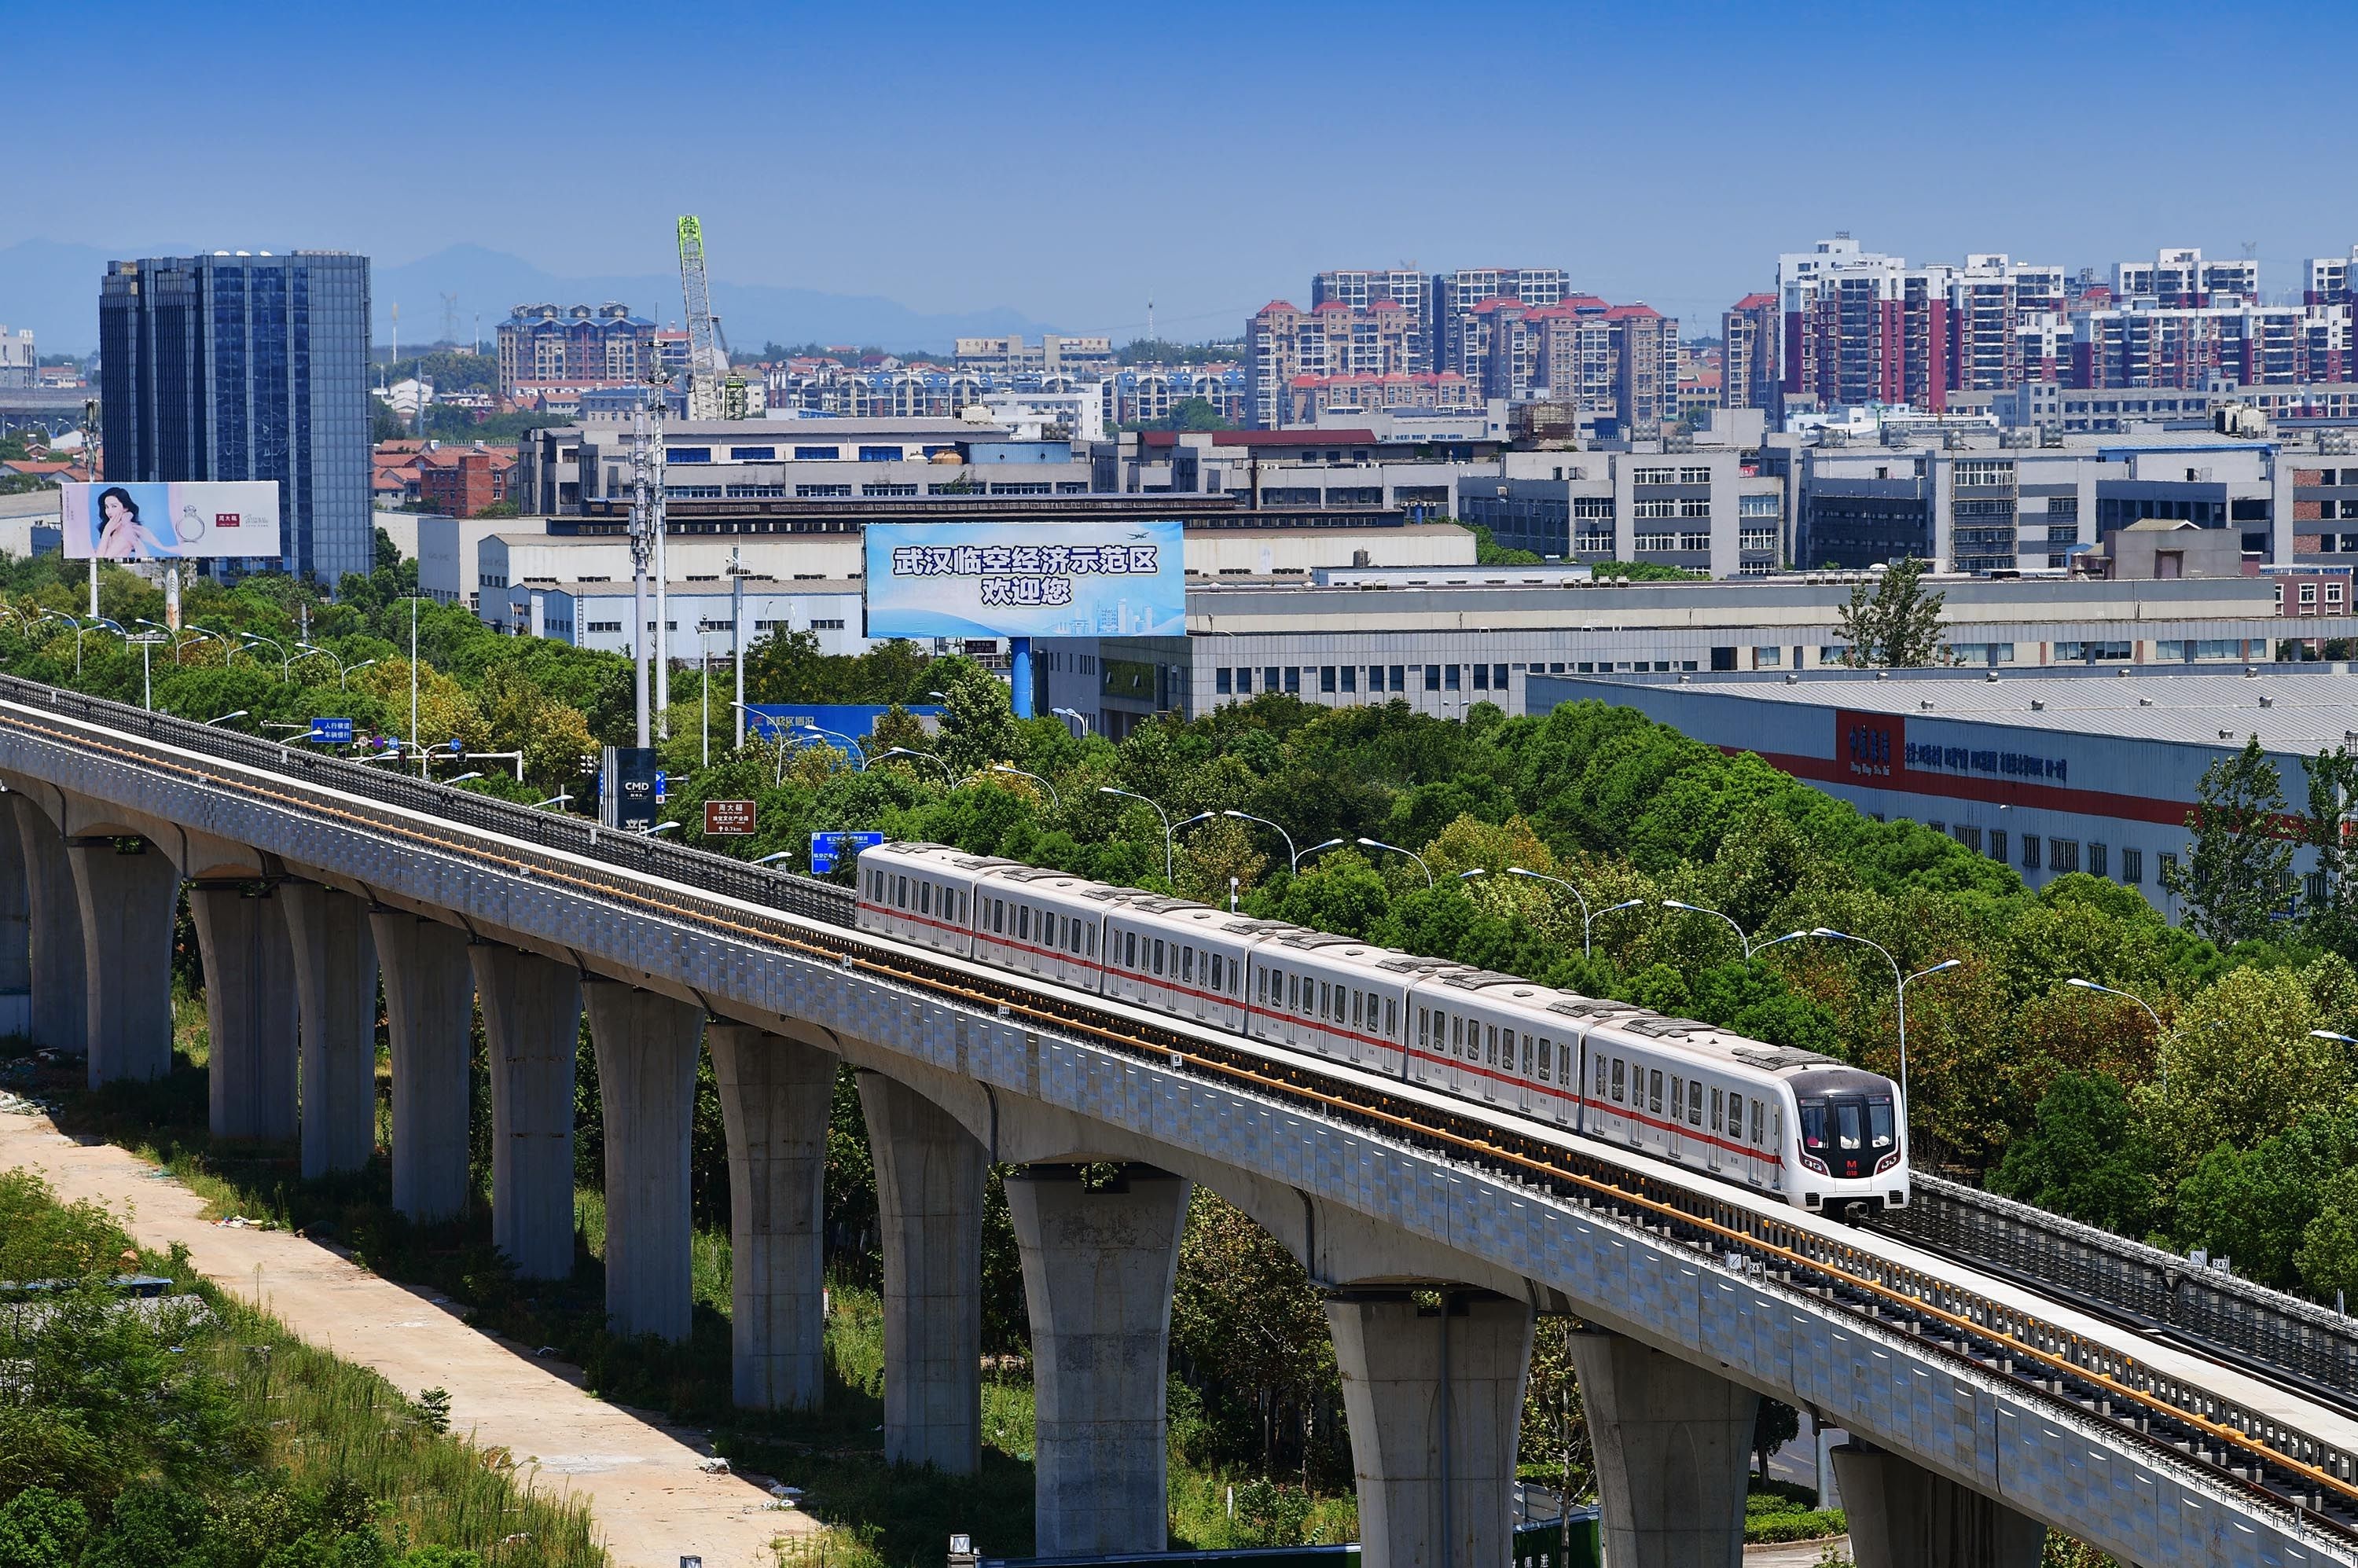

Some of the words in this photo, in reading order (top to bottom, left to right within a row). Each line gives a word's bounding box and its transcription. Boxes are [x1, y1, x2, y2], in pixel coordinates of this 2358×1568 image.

[893, 545, 1159, 576] 武汉临空经济示范区
[981, 577, 1072, 606] 欢迎您
[625, 782, 649, 791] CMD
